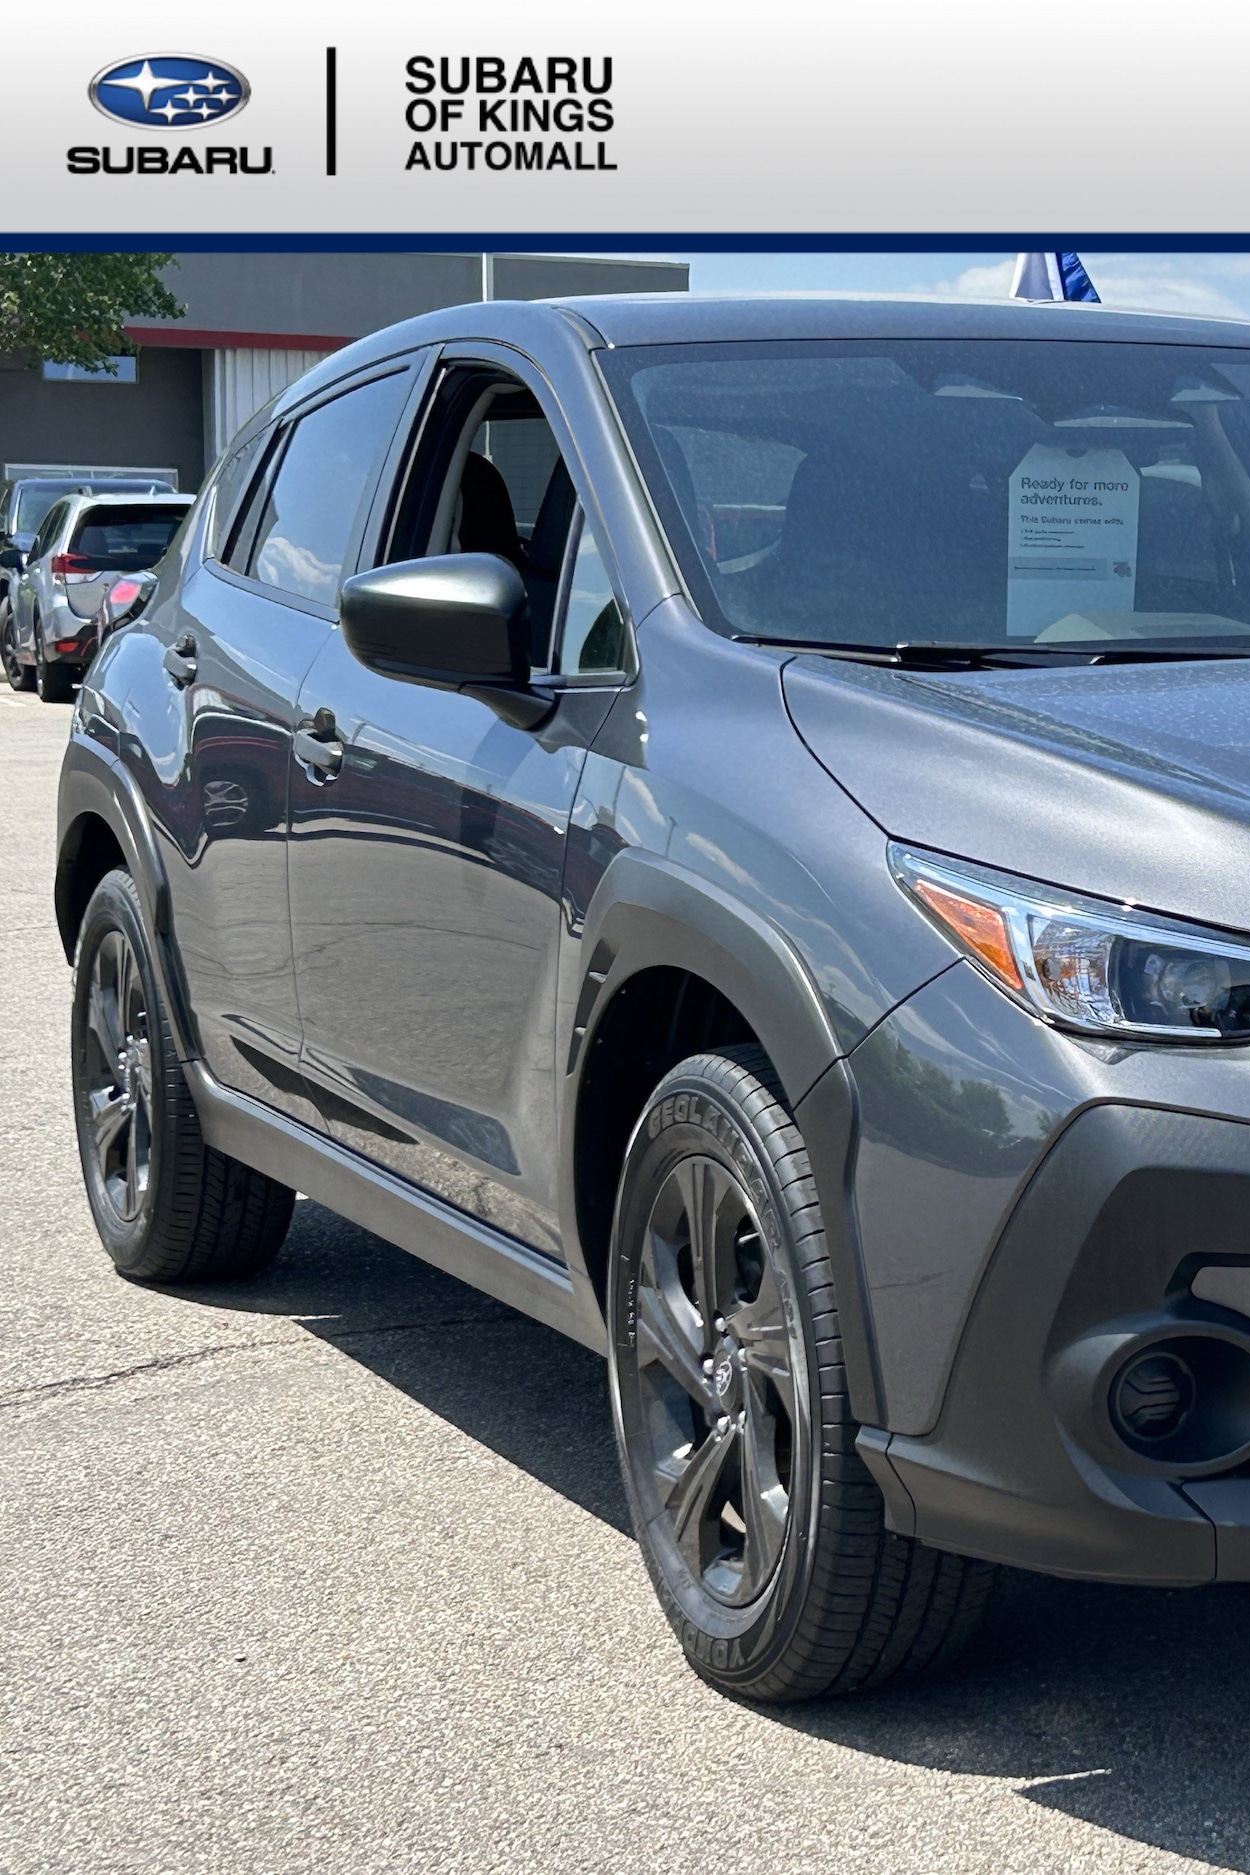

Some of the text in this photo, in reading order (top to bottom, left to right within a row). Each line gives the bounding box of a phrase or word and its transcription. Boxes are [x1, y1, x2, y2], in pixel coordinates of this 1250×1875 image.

[1021, 477, 1129, 492] Ready for more
